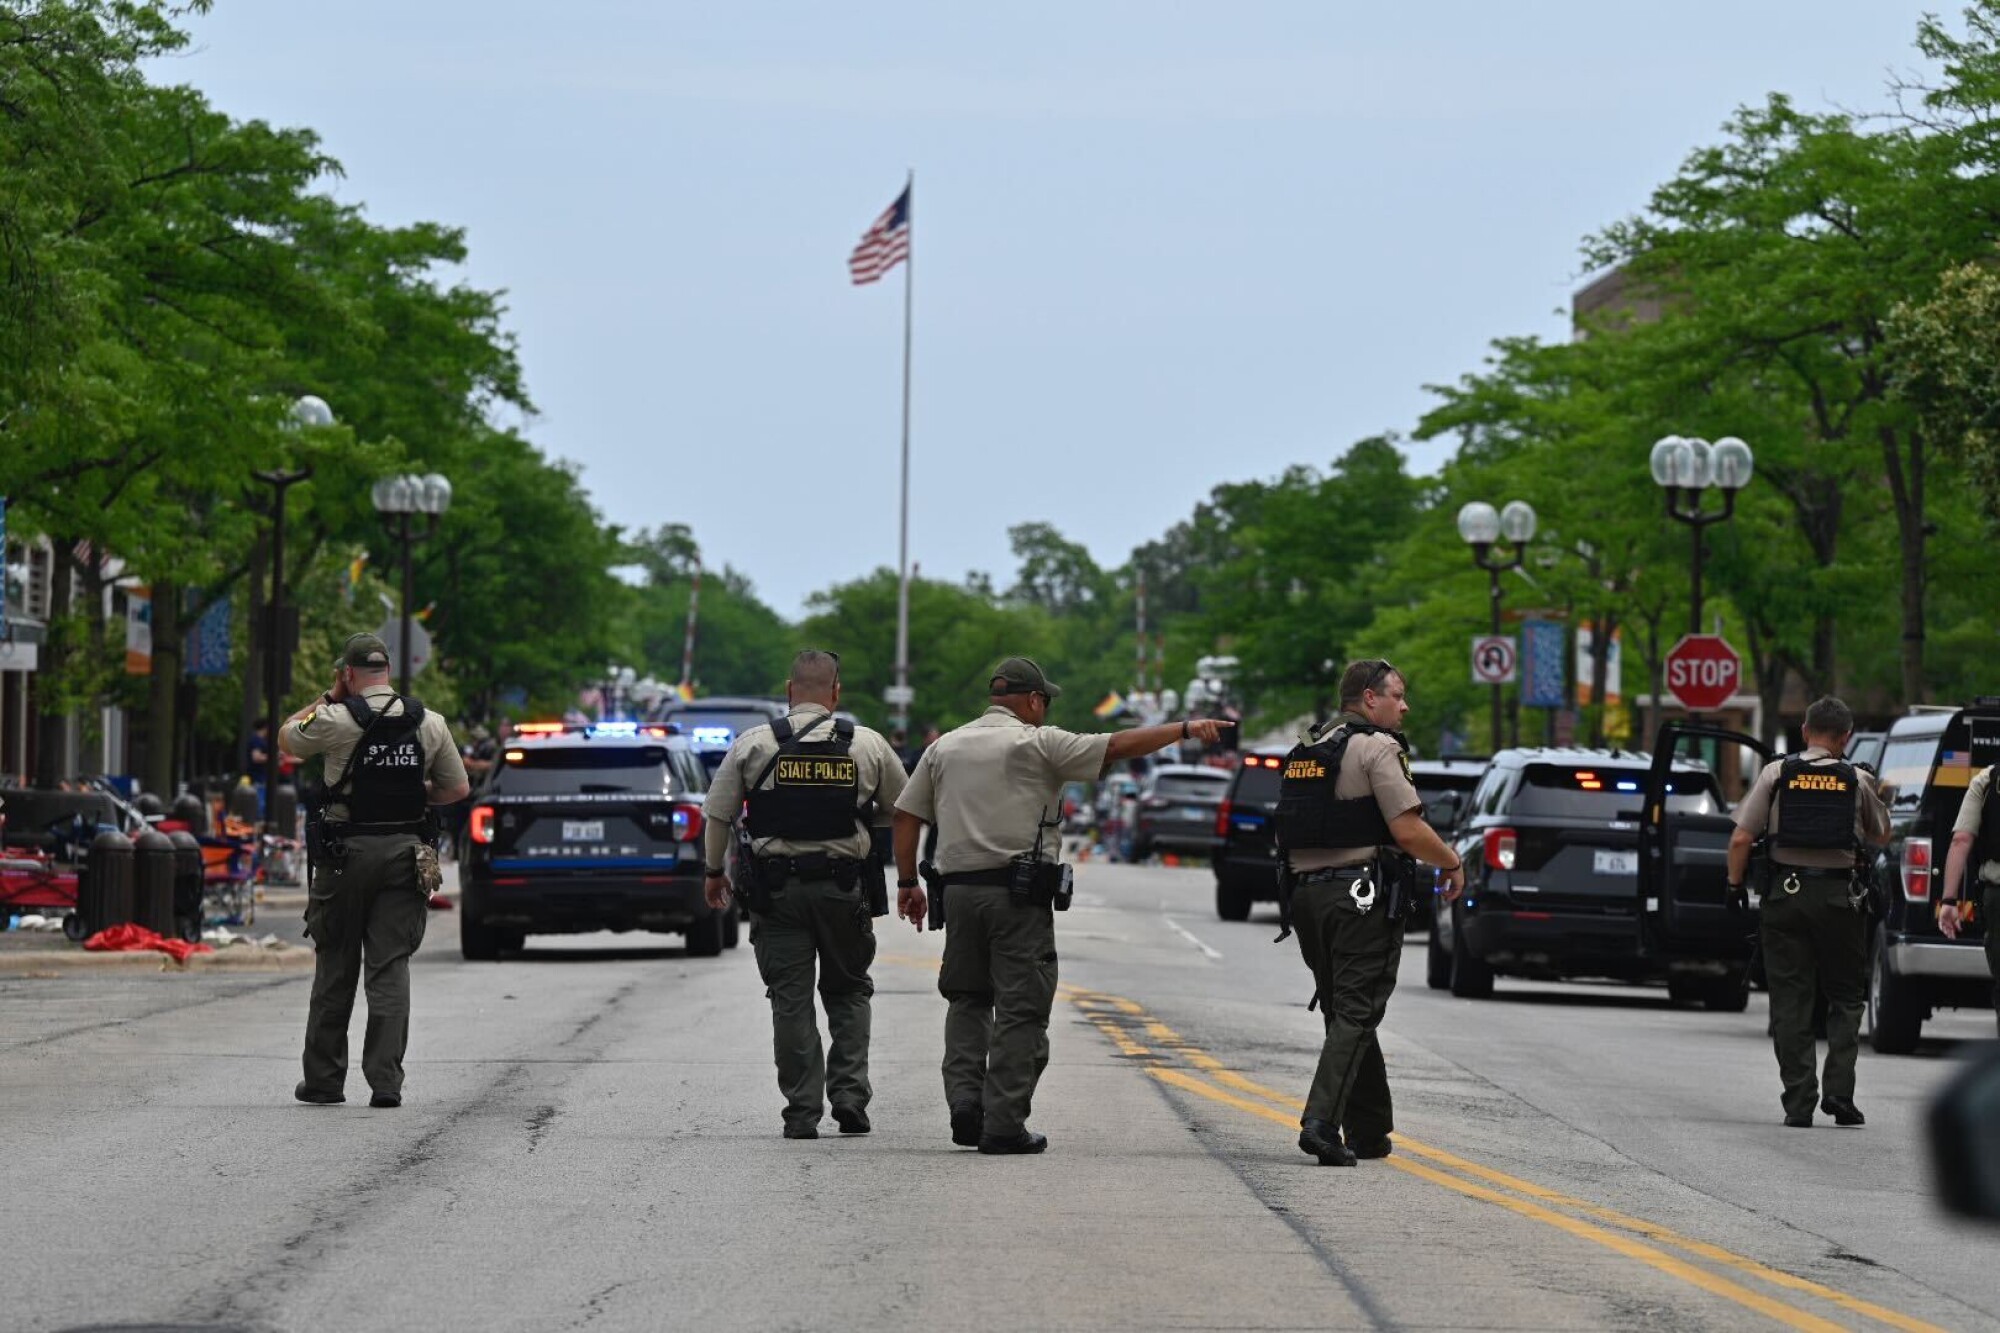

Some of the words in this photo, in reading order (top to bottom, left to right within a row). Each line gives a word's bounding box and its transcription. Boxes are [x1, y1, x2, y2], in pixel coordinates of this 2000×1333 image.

[1670, 659, 1735, 687] STOP
[368, 744, 415, 755] STTE
[1288, 760, 1317, 769] STATE
[779, 761, 812, 779] STATE
[814, 762, 853, 780] POLICE
[1283, 767, 1326, 779] POLICE
[1796, 774, 1838, 782] STATE
[1788, 780, 1847, 791] POLICE
